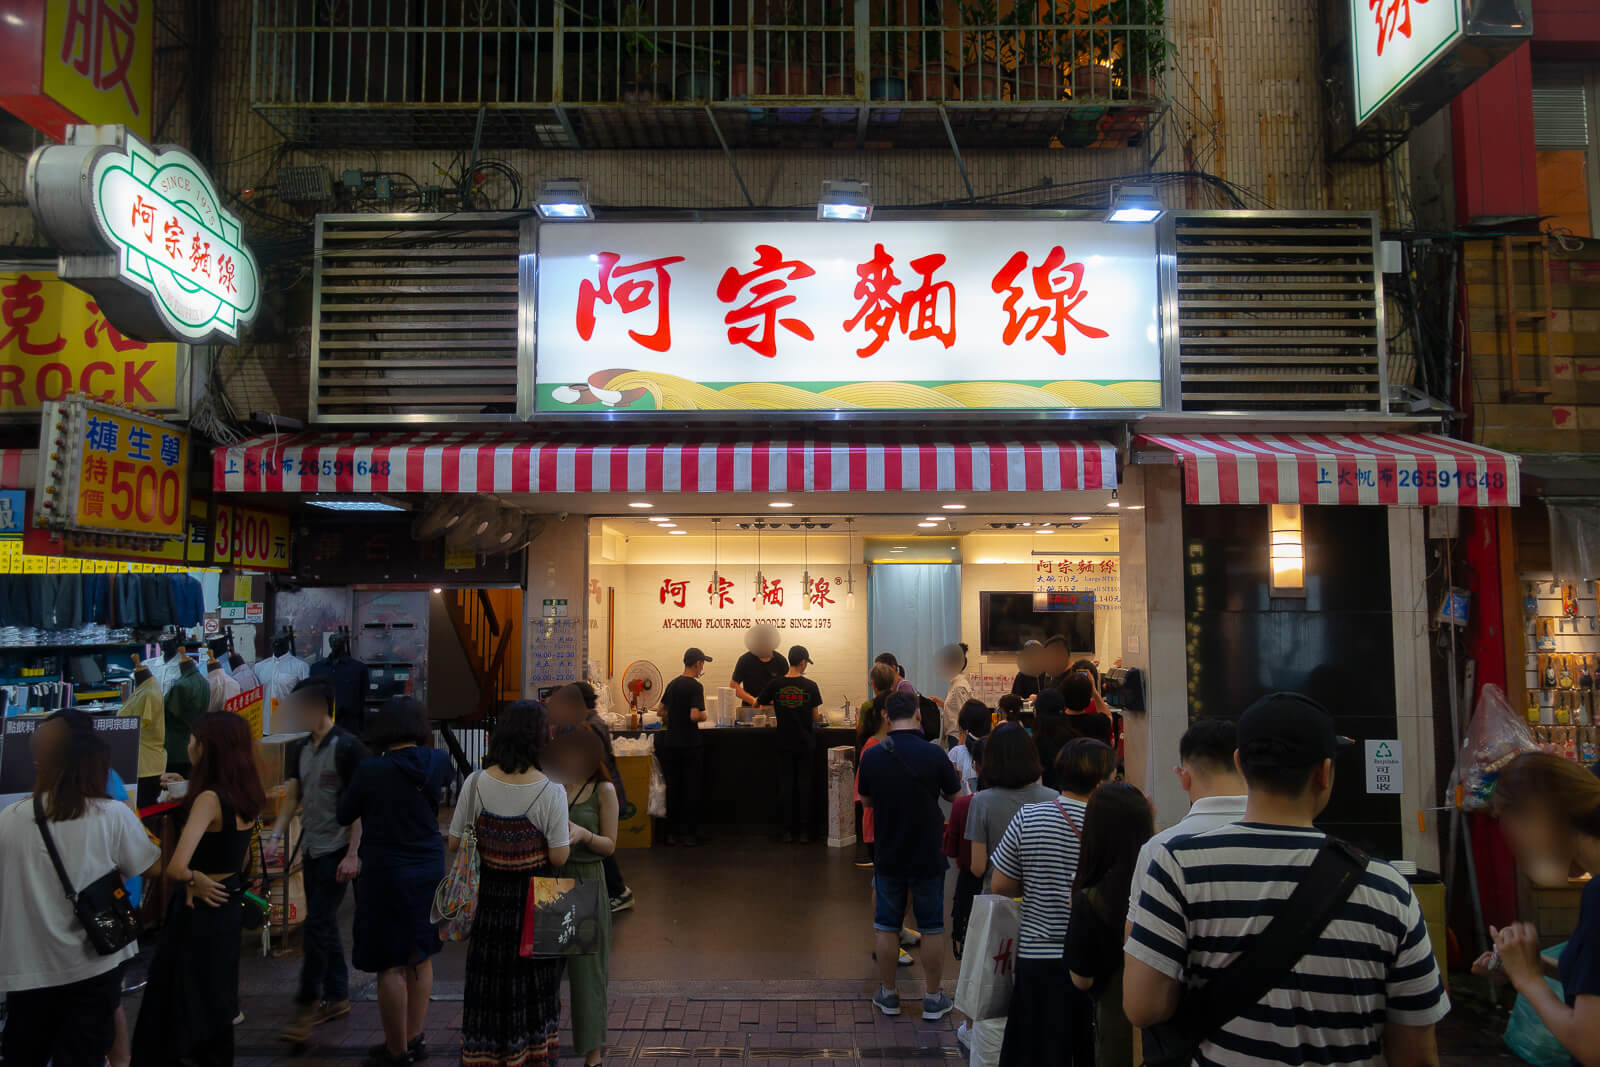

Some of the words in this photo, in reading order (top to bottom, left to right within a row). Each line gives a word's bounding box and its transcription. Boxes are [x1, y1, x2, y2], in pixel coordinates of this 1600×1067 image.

[161, 176, 191, 193] SINCE
[132, 194, 238, 294] 阿宗麵線
[575, 242, 1110, 359] 阿宗麵線
[112, 460, 180, 526] 500
[662, 618, 702, 629] AY-CHUNG
[705, 618, 751, 629] FLOUR-RICE
[789, 618, 813, 629] SINCE
[814, 618, 832, 629] 1975
[1376, 766, 1391, 791] 可回收
